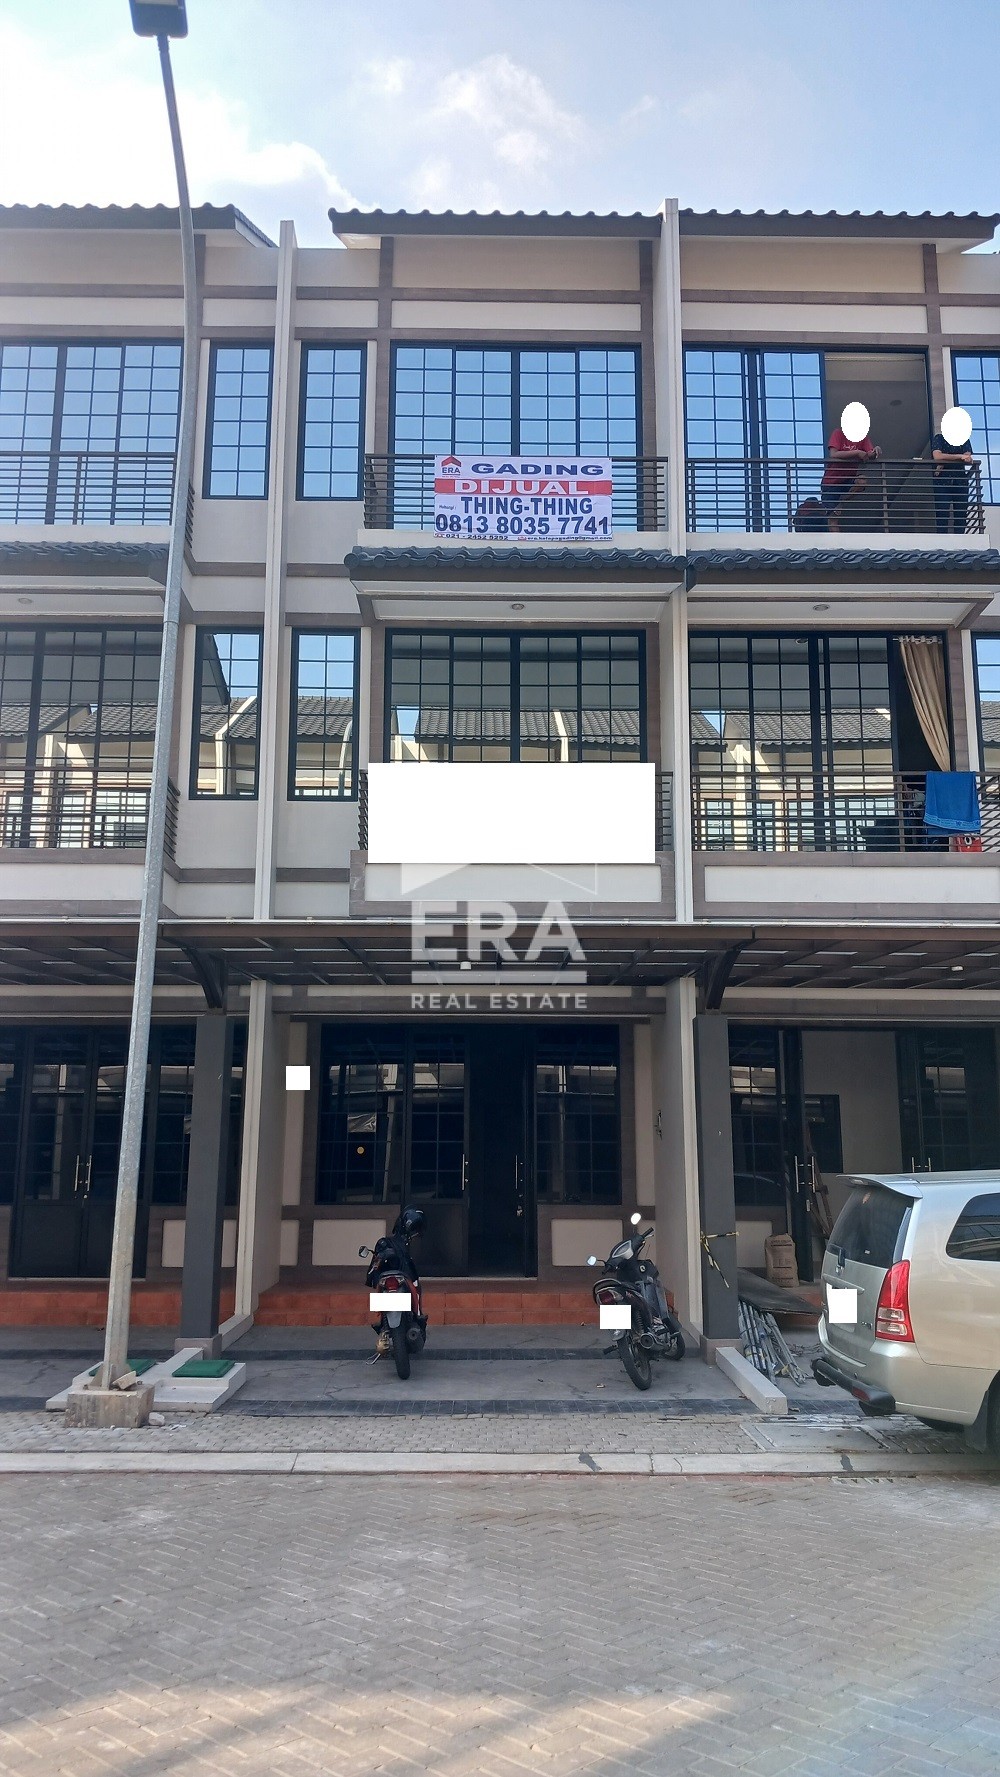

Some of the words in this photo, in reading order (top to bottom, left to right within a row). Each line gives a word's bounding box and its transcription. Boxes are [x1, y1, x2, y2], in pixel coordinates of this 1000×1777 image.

[472, 464, 604, 476] GADING
[454, 480, 588, 494] DIJUAL
[460, 497, 593, 515] THING-THING
[436, 514, 488, 533] 0813
[496, 516, 550, 534] 8035
[558, 516, 608, 534] 7741
